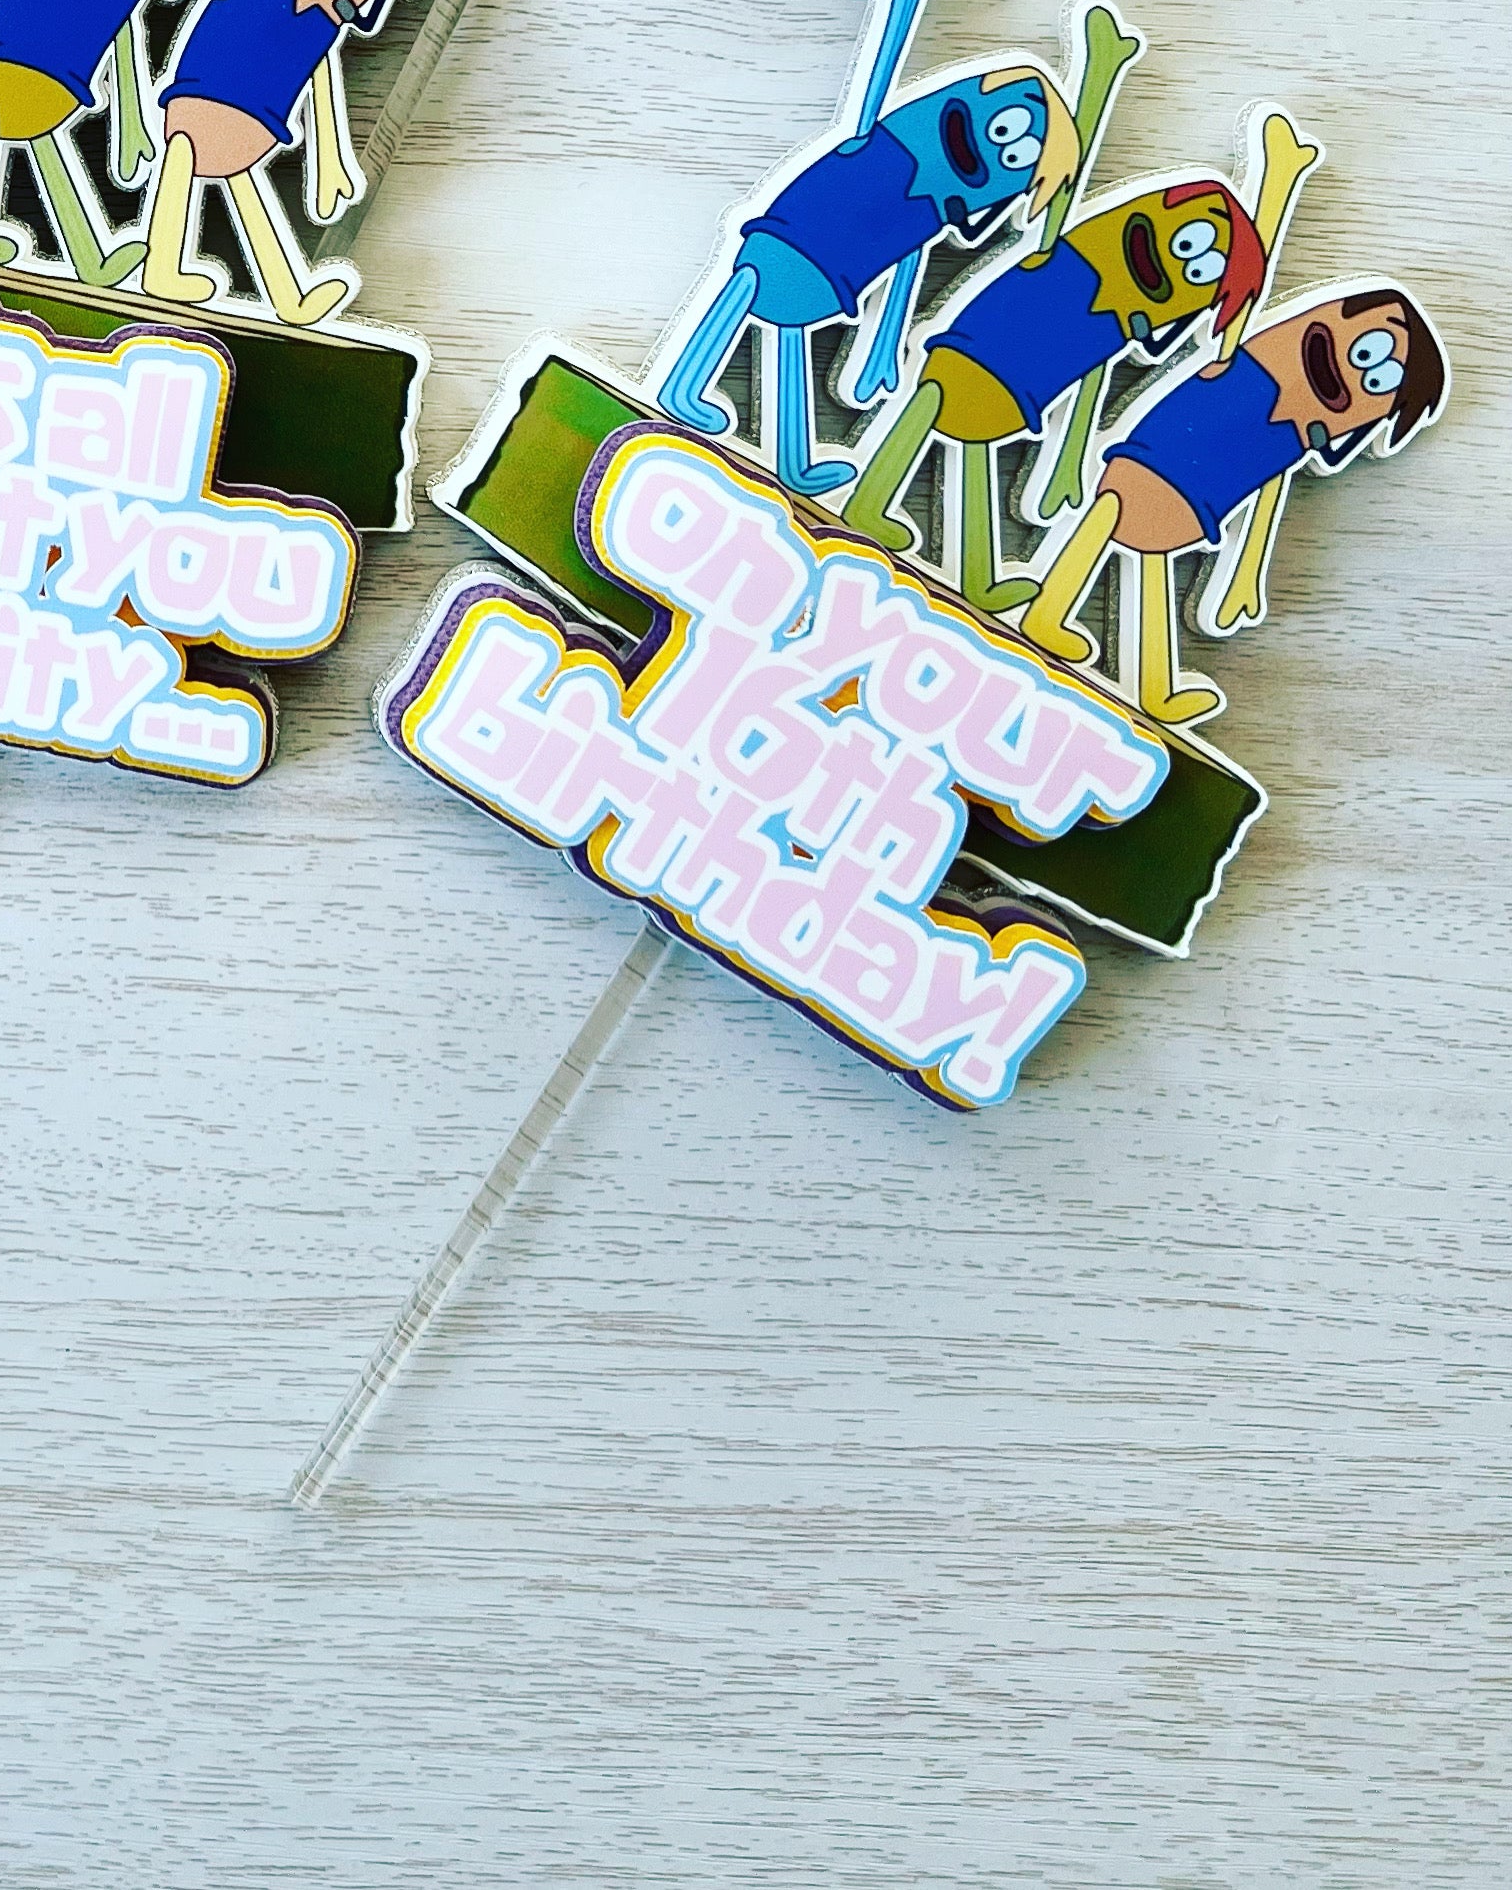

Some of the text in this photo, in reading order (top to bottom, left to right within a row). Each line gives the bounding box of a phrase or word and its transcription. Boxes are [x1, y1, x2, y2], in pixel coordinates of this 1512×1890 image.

[45, 370, 195, 490] all
[60, 497, 324, 626] you
[647, 631, 943, 891] 16th
[803, 576, 1149, 818] your
[452, 639, 1059, 1088] birthday!
